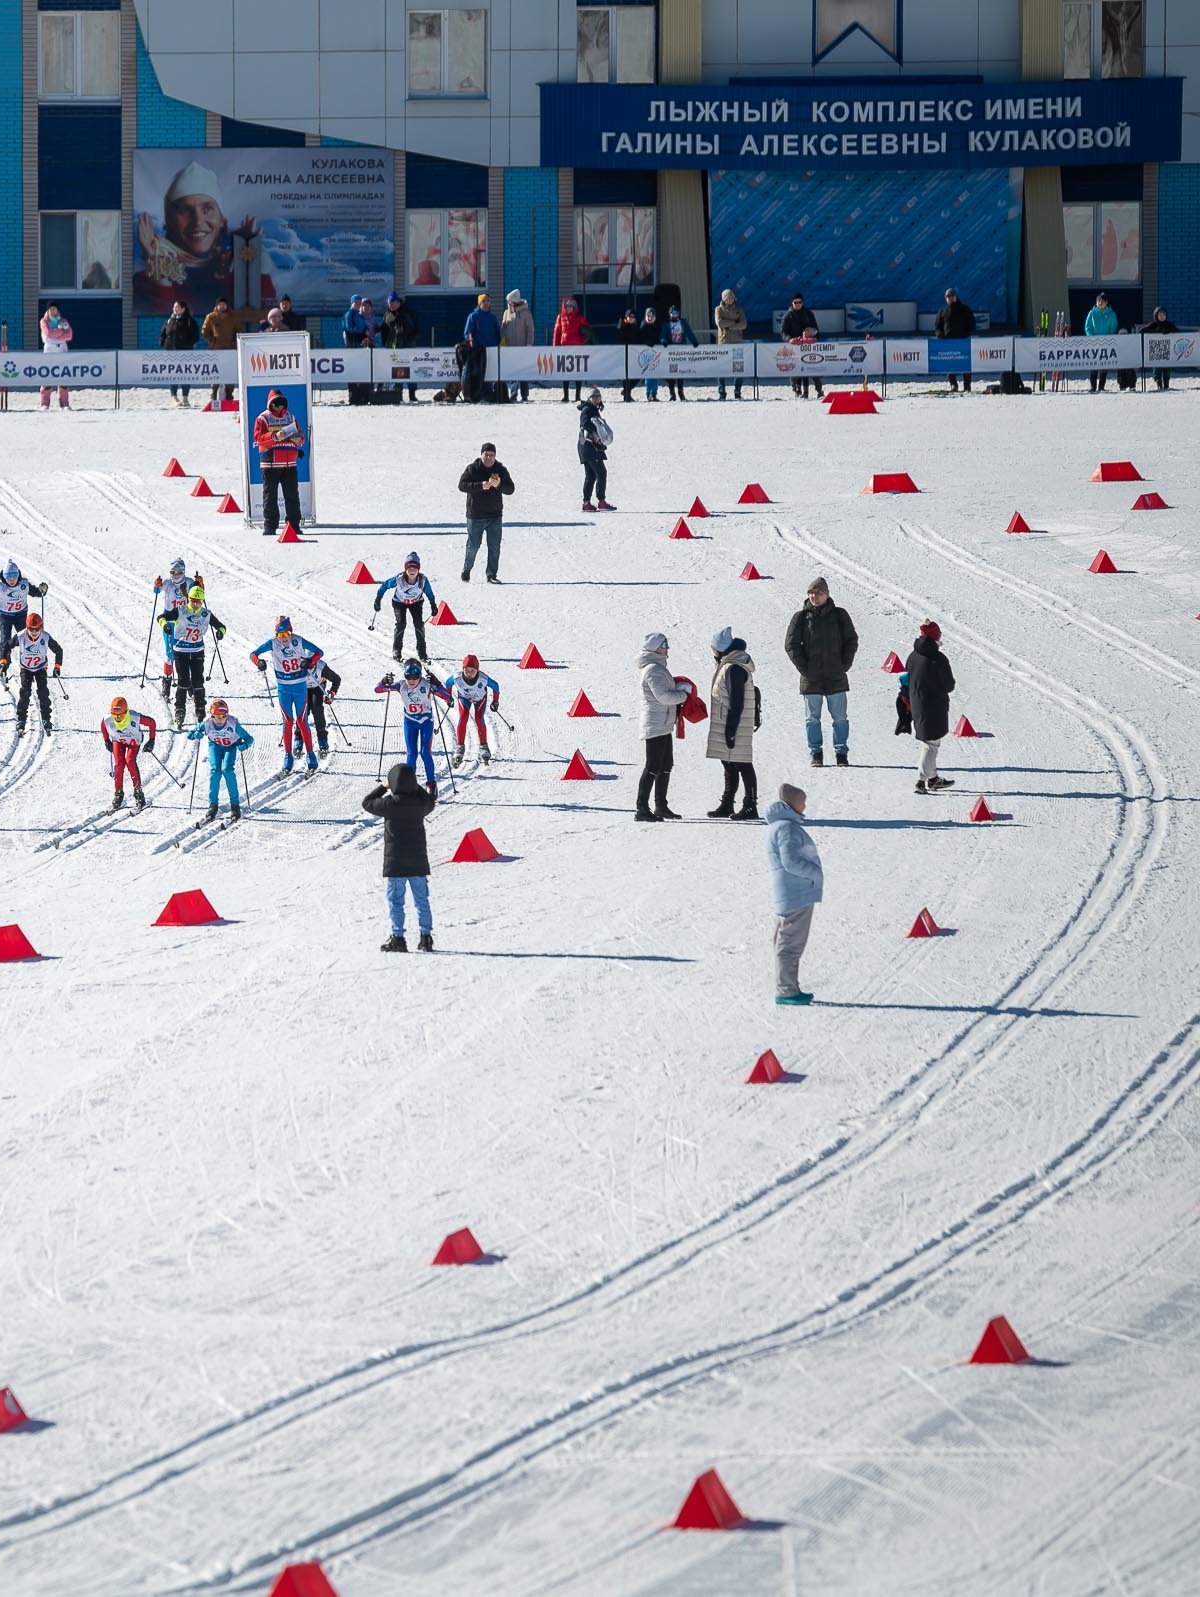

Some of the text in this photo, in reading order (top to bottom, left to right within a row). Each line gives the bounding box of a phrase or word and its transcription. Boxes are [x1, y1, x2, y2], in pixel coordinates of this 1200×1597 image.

[648, 96, 1082, 123] ЛЫЖНЫЙ КОМПЛЕКС ИМЕНИ
[600, 122, 1132, 156] ГАЛИНЫ АЛЕКСЕЕВНЫ КУЛАКОВОЙ
[312, 158, 385, 169] КУЛАКОВА
[238, 174, 385, 185] ГАЛИНА АЛЕКСЕЕВНА
[270, 193, 307, 201] ПОБЕДЫ
[324, 192, 385, 200] ОЛИМПИАДАХ
[903, 351, 920, 362] ИЗТТ
[989, 350, 1006, 360] ИЗТТ
[1039, 347, 1117, 361] БАРРАКУДА
[269, 353, 301, 370] ИЗТТ
[556, 354, 590, 374] ИЗТТ
[23, 365, 103, 378] ФОСАГРО
[142, 363, 219, 376] БАРРАКУДА
[6, 600, 23, 612] 75
[185, 628, 200, 643] 73
[24, 656, 41, 668] 72
[282, 658, 299, 673] 68
